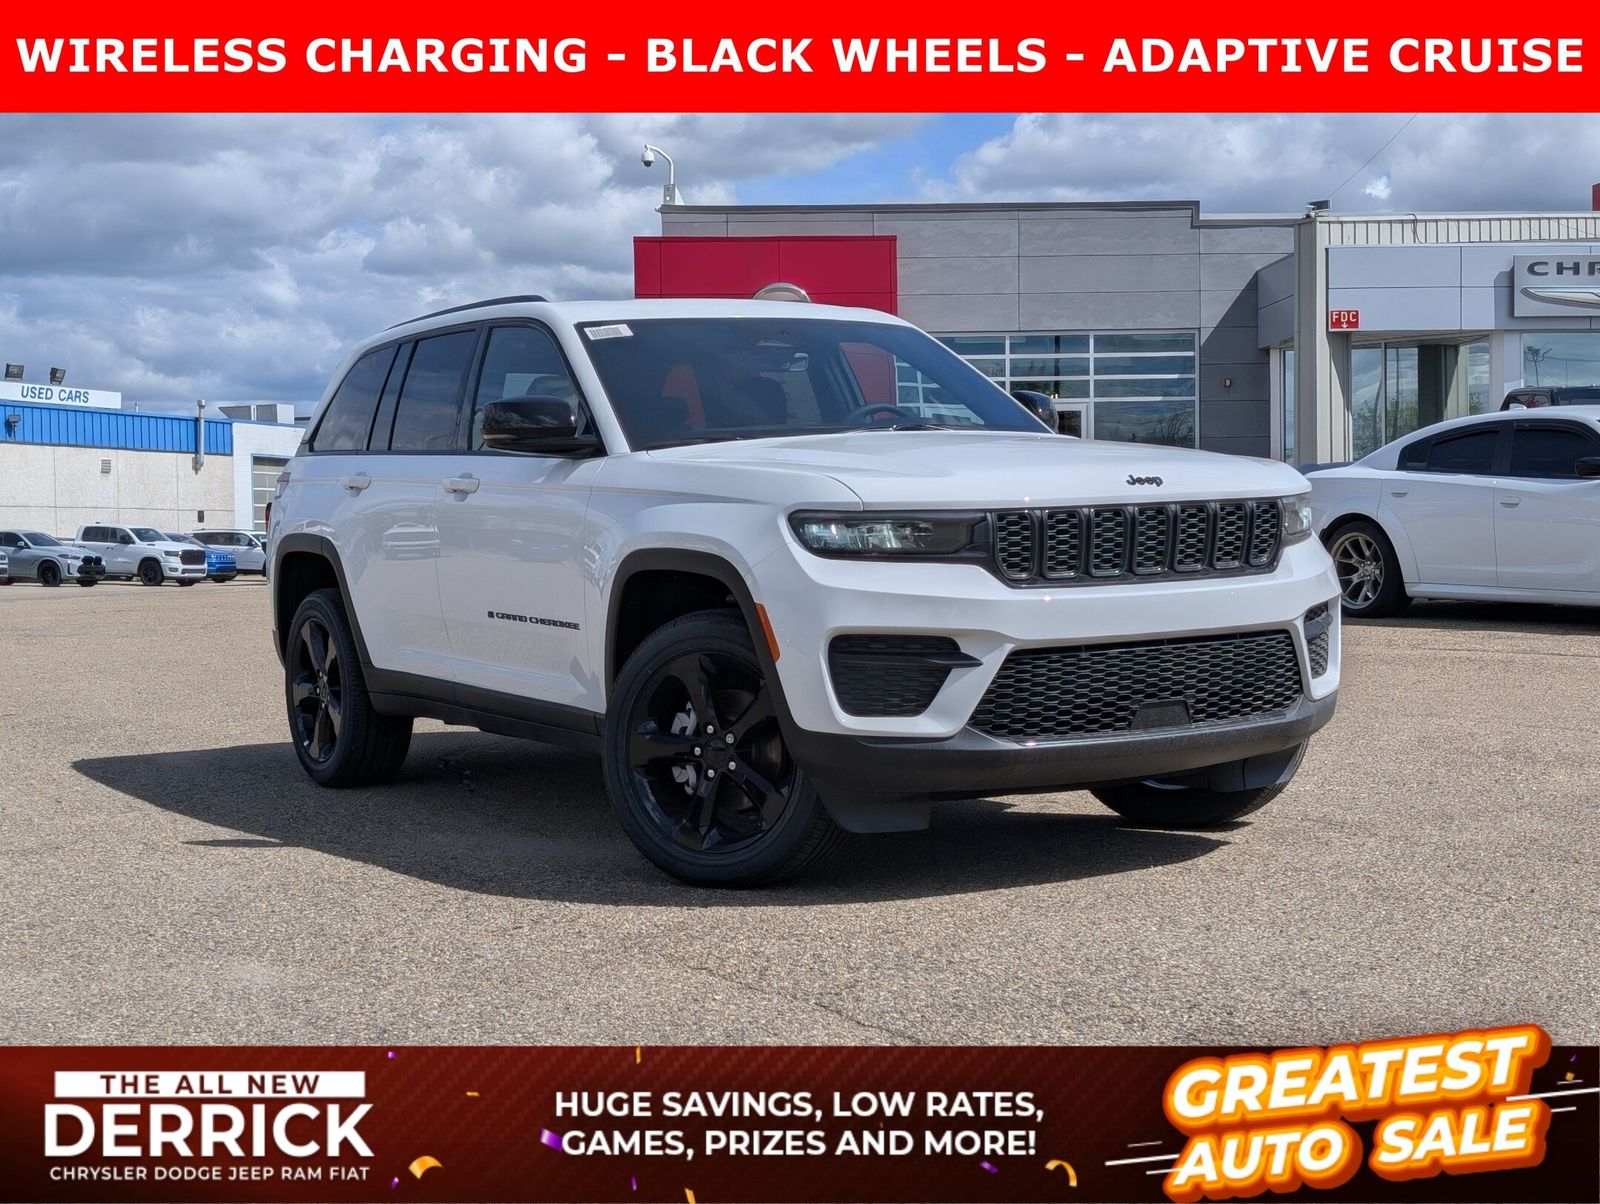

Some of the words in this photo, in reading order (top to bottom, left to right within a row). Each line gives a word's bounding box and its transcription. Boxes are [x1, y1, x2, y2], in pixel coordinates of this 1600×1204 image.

[1332, 311, 1358, 323] FDC
[20, 385, 53, 400] USED
[58, 387, 90, 404] CARS
[1126, 474, 1164, 488] Jeep
[495, 611, 528, 623] GRAND
[529, 616, 581, 631] CHEROKEE
